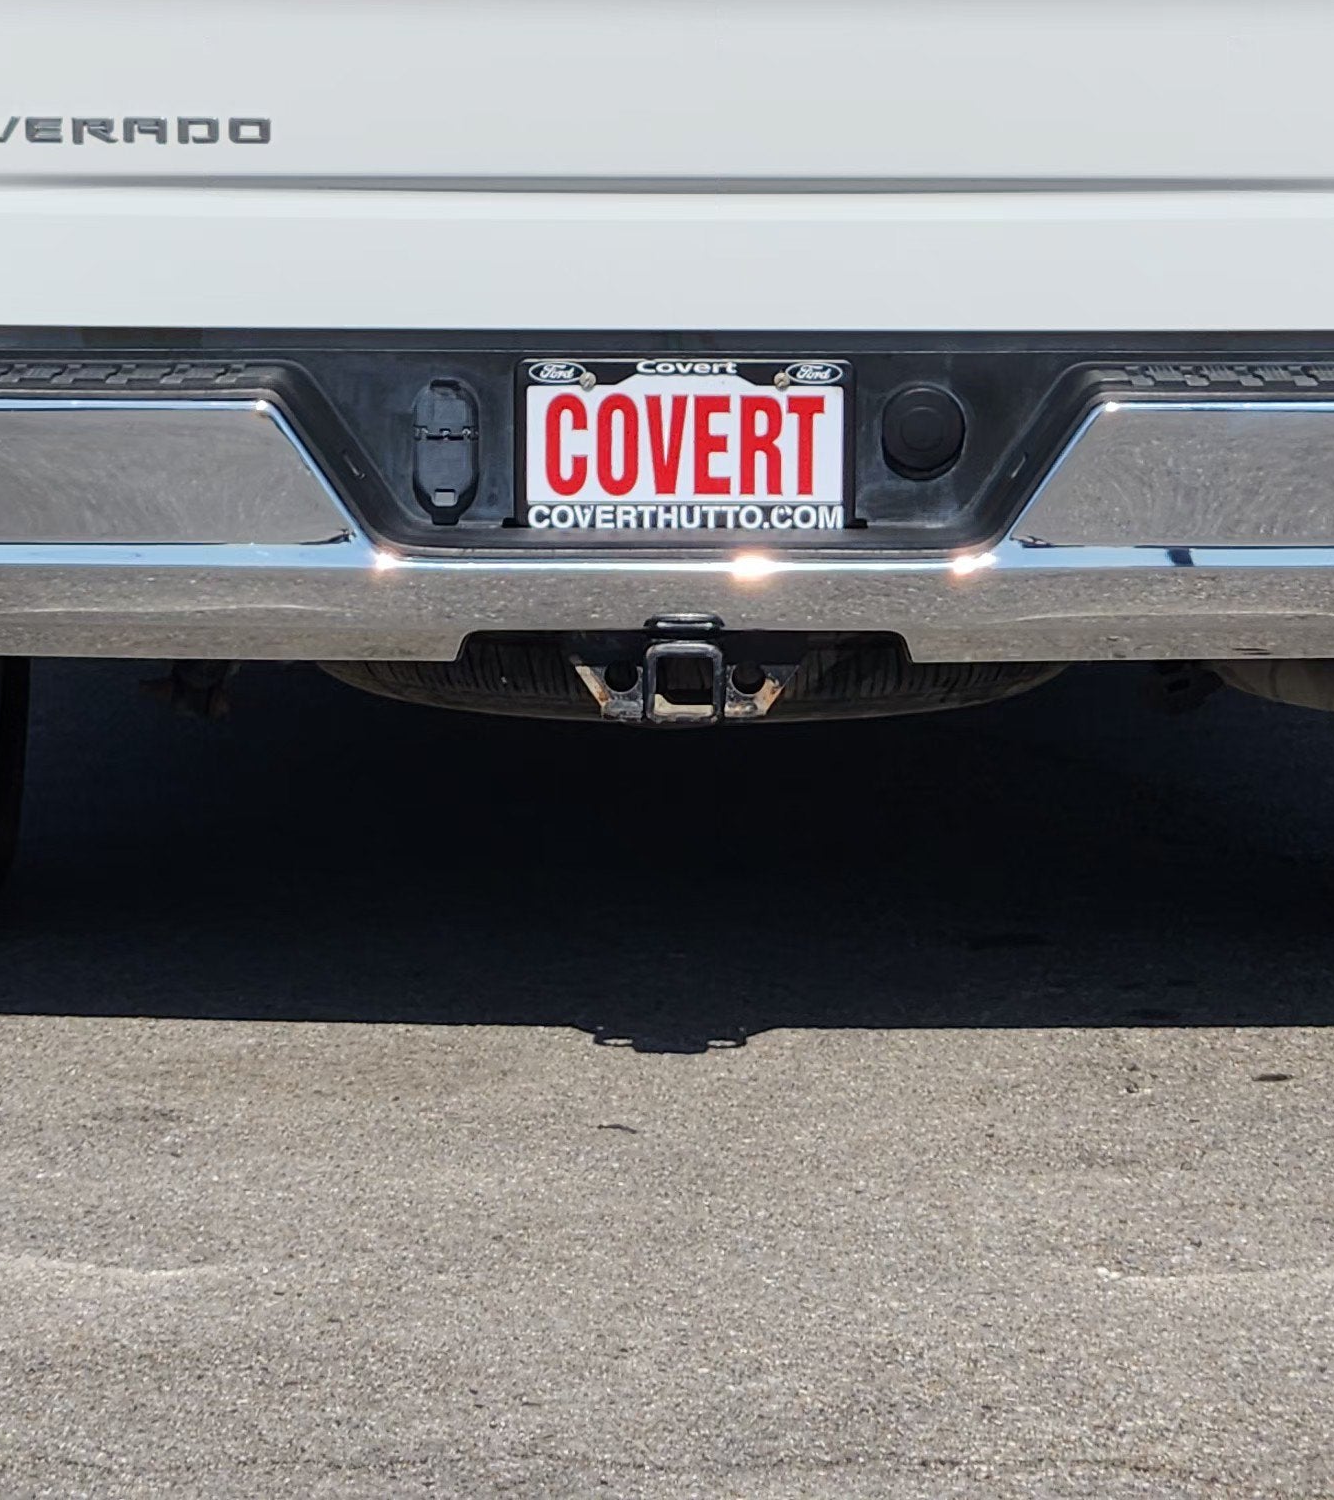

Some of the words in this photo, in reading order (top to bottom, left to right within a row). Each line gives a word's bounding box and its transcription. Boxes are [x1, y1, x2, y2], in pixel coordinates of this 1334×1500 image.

[539, 364, 576, 380] Ford
[636, 361, 738, 375] Covert
[795, 365, 831, 381] Ford
[545, 393, 826, 497] COVERT
[527, 504, 845, 530] COVERTHUTTO.COM
